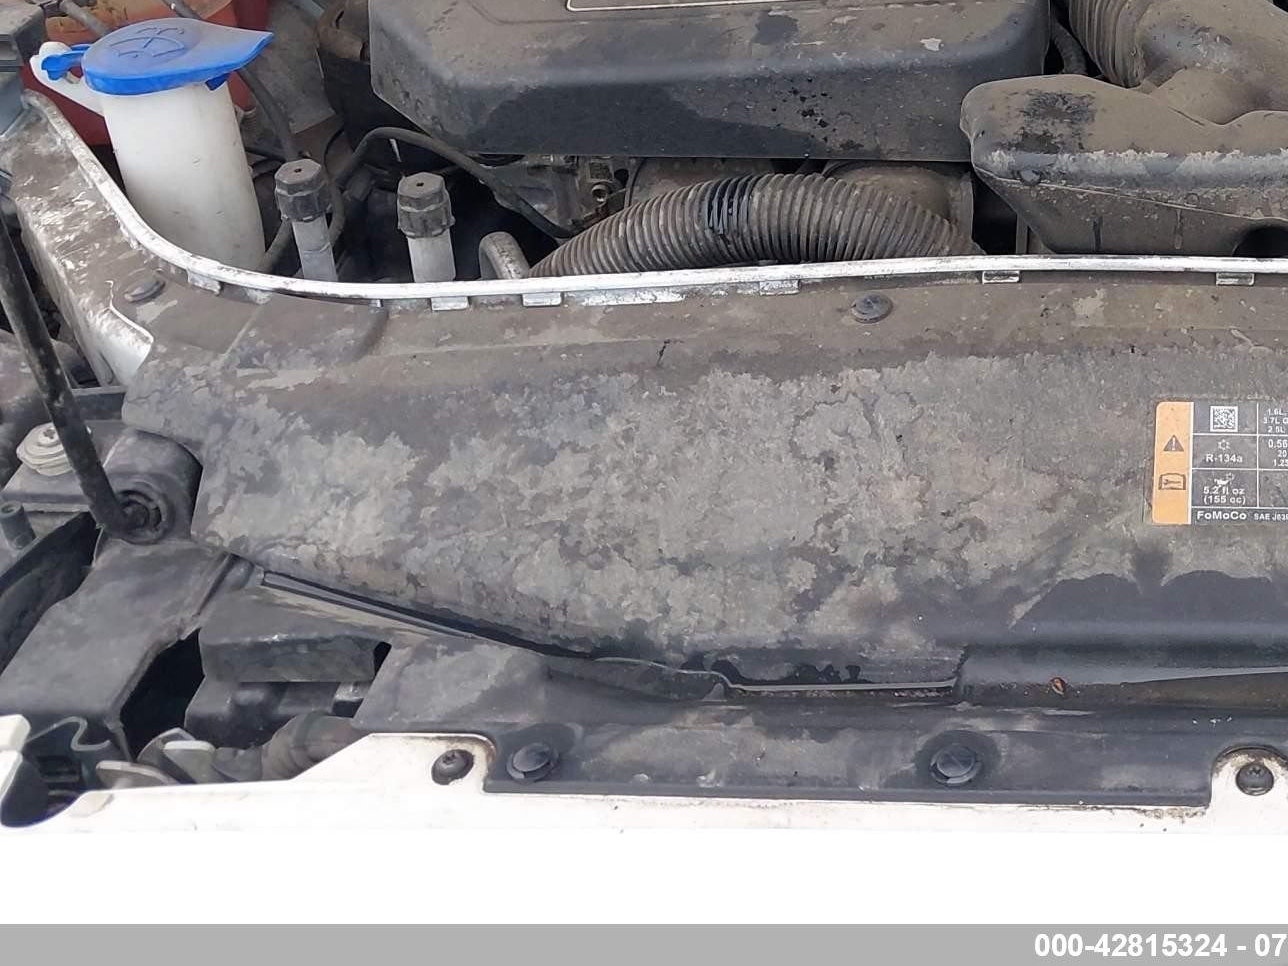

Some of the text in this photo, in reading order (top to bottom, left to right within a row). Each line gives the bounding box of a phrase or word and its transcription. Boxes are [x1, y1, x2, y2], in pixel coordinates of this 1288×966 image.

[1277, 450, 1287, 458] 20
[1205, 454, 1243, 463] R-134a
[1203, 486, 1219, 494] 5.2
[1203, 495, 1246, 504] (155 cc)
[1196, 510, 1247, 520] FoMoCo
[1253, 513, 1270, 521] SAE
